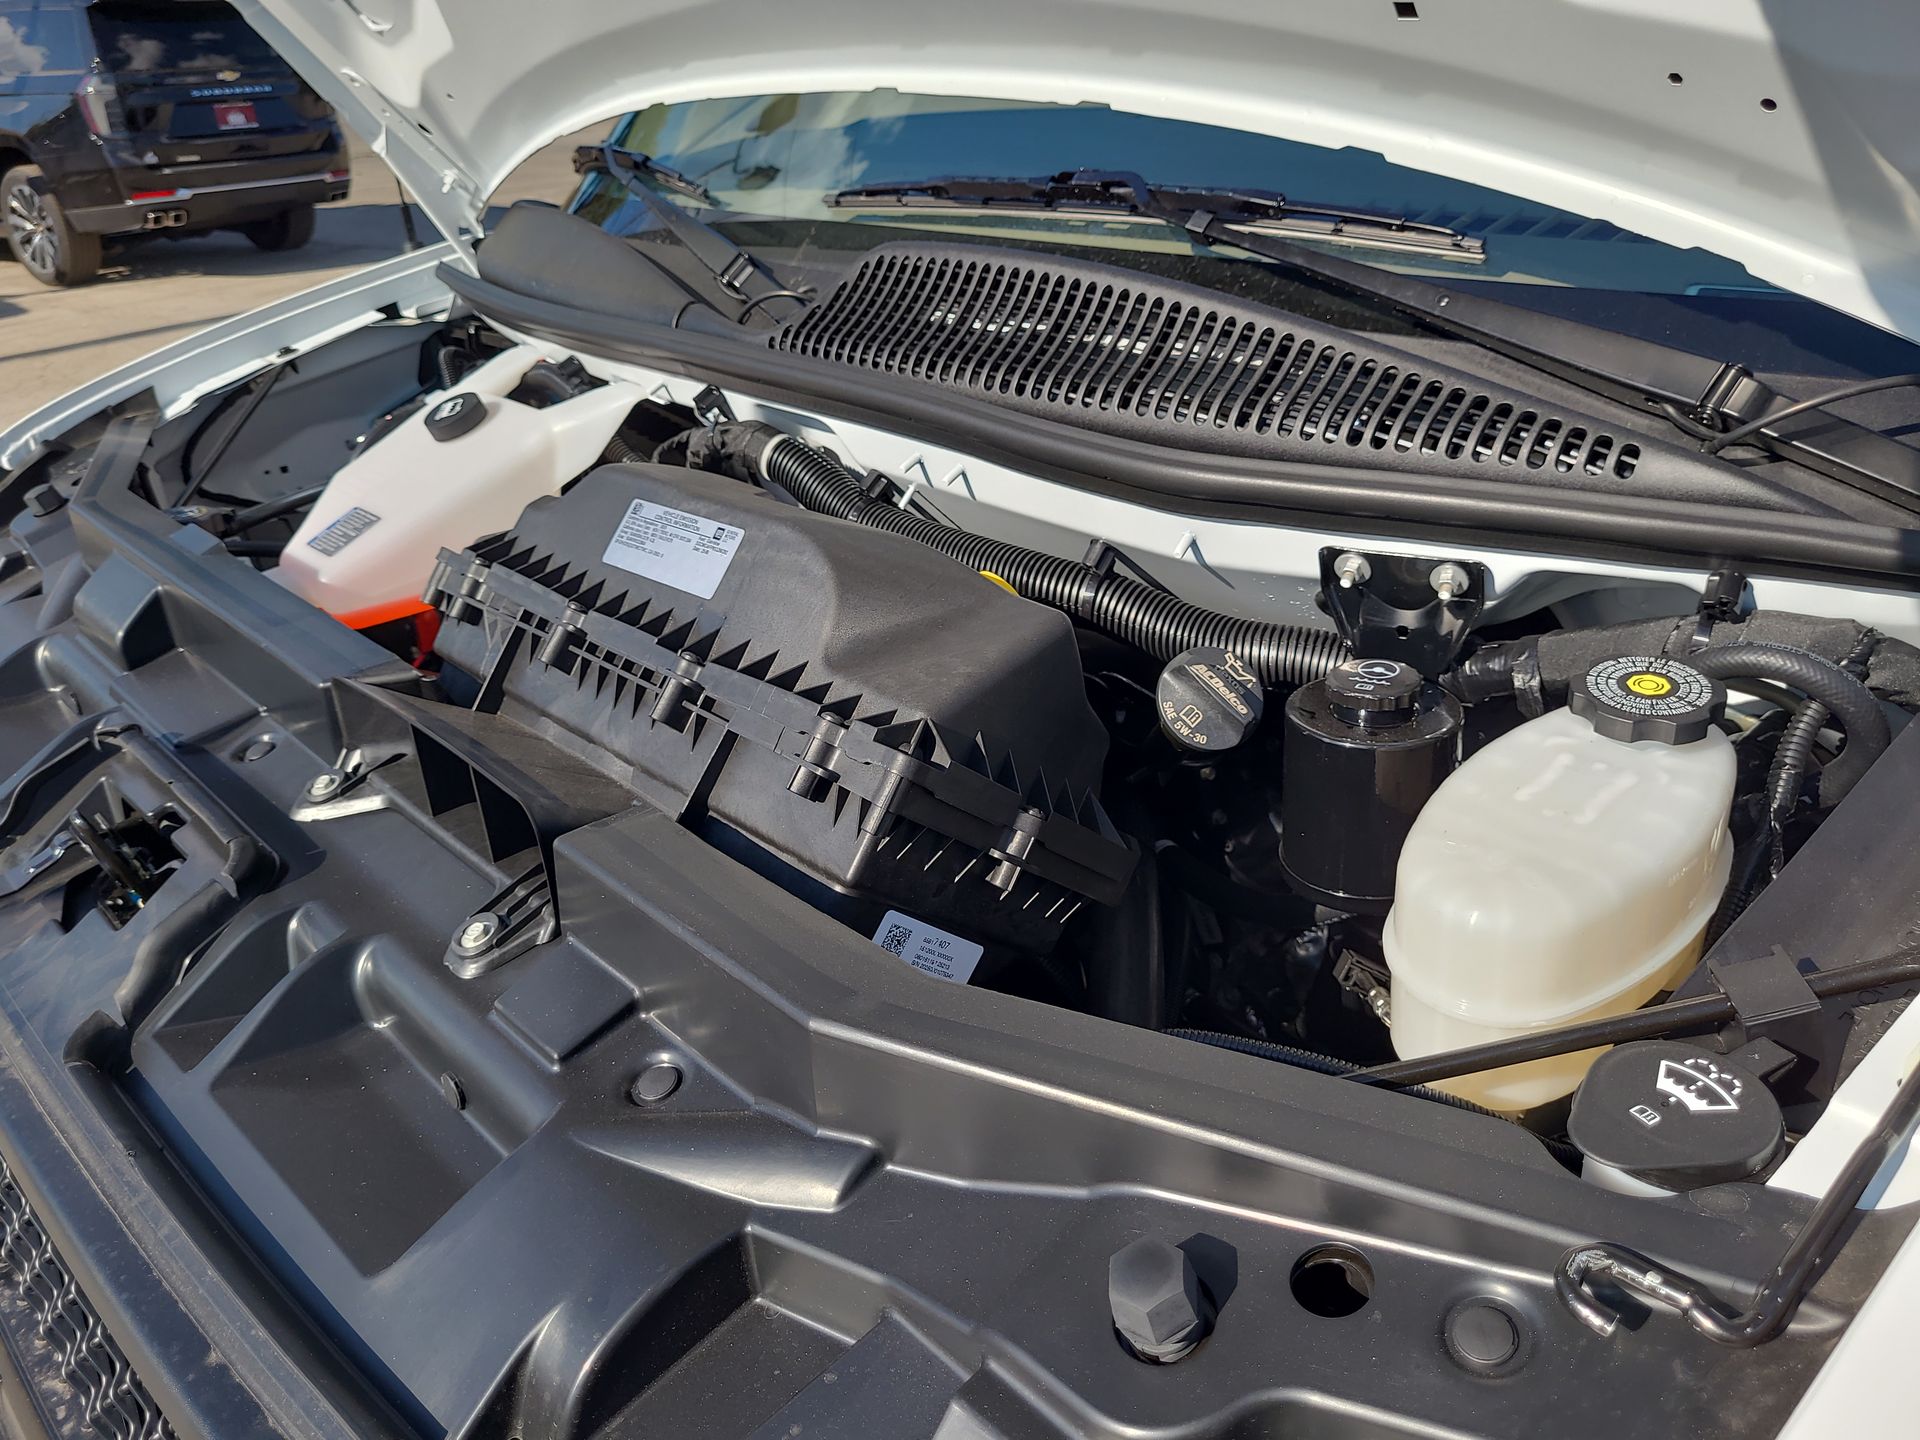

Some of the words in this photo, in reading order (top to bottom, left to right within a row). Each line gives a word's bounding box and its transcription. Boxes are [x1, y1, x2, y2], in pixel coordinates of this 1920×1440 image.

[1190, 664, 1248, 715] ACDelco
[1626, 695, 1651, 704] CLEAN
[1162, 701, 1178, 720] SAE
[1174, 720, 1208, 745] 5W-30
[1620, 703, 1652, 715] SEALED
